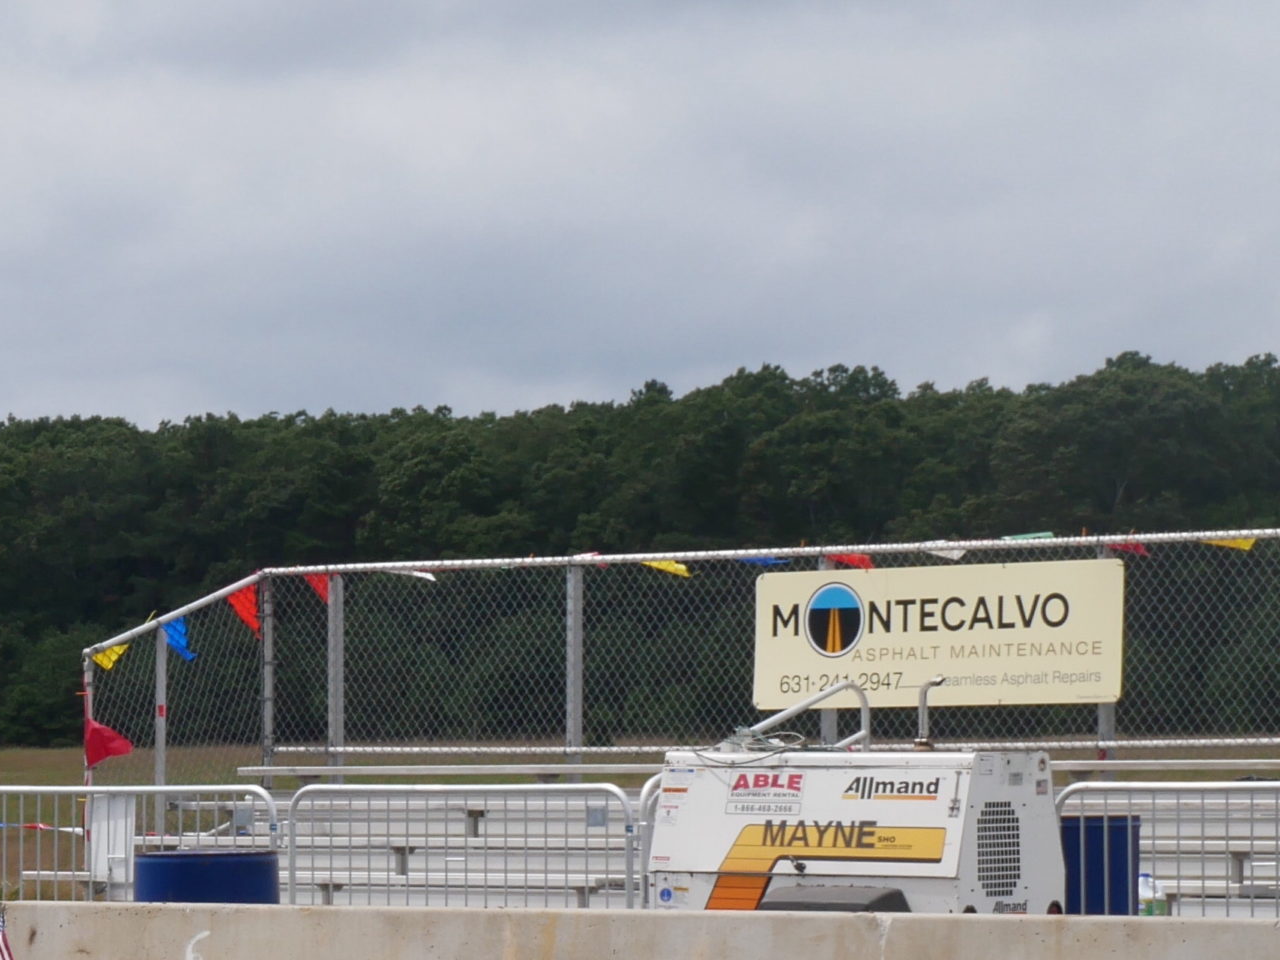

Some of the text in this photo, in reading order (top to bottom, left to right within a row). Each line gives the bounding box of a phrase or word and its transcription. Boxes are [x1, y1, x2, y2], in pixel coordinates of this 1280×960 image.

[851, 640, 1103, 663] ASPHALT MAINTENANCE
[1000, 671, 1049, 687] Asphalt
[1052, 669, 1102, 684] Repairs
[731, 773, 803, 792] ABLE
[844, 777, 940, 800] Allmand
[761, 819, 878, 849] MAYNE
[992, 900, 1028, 914] Allmand
